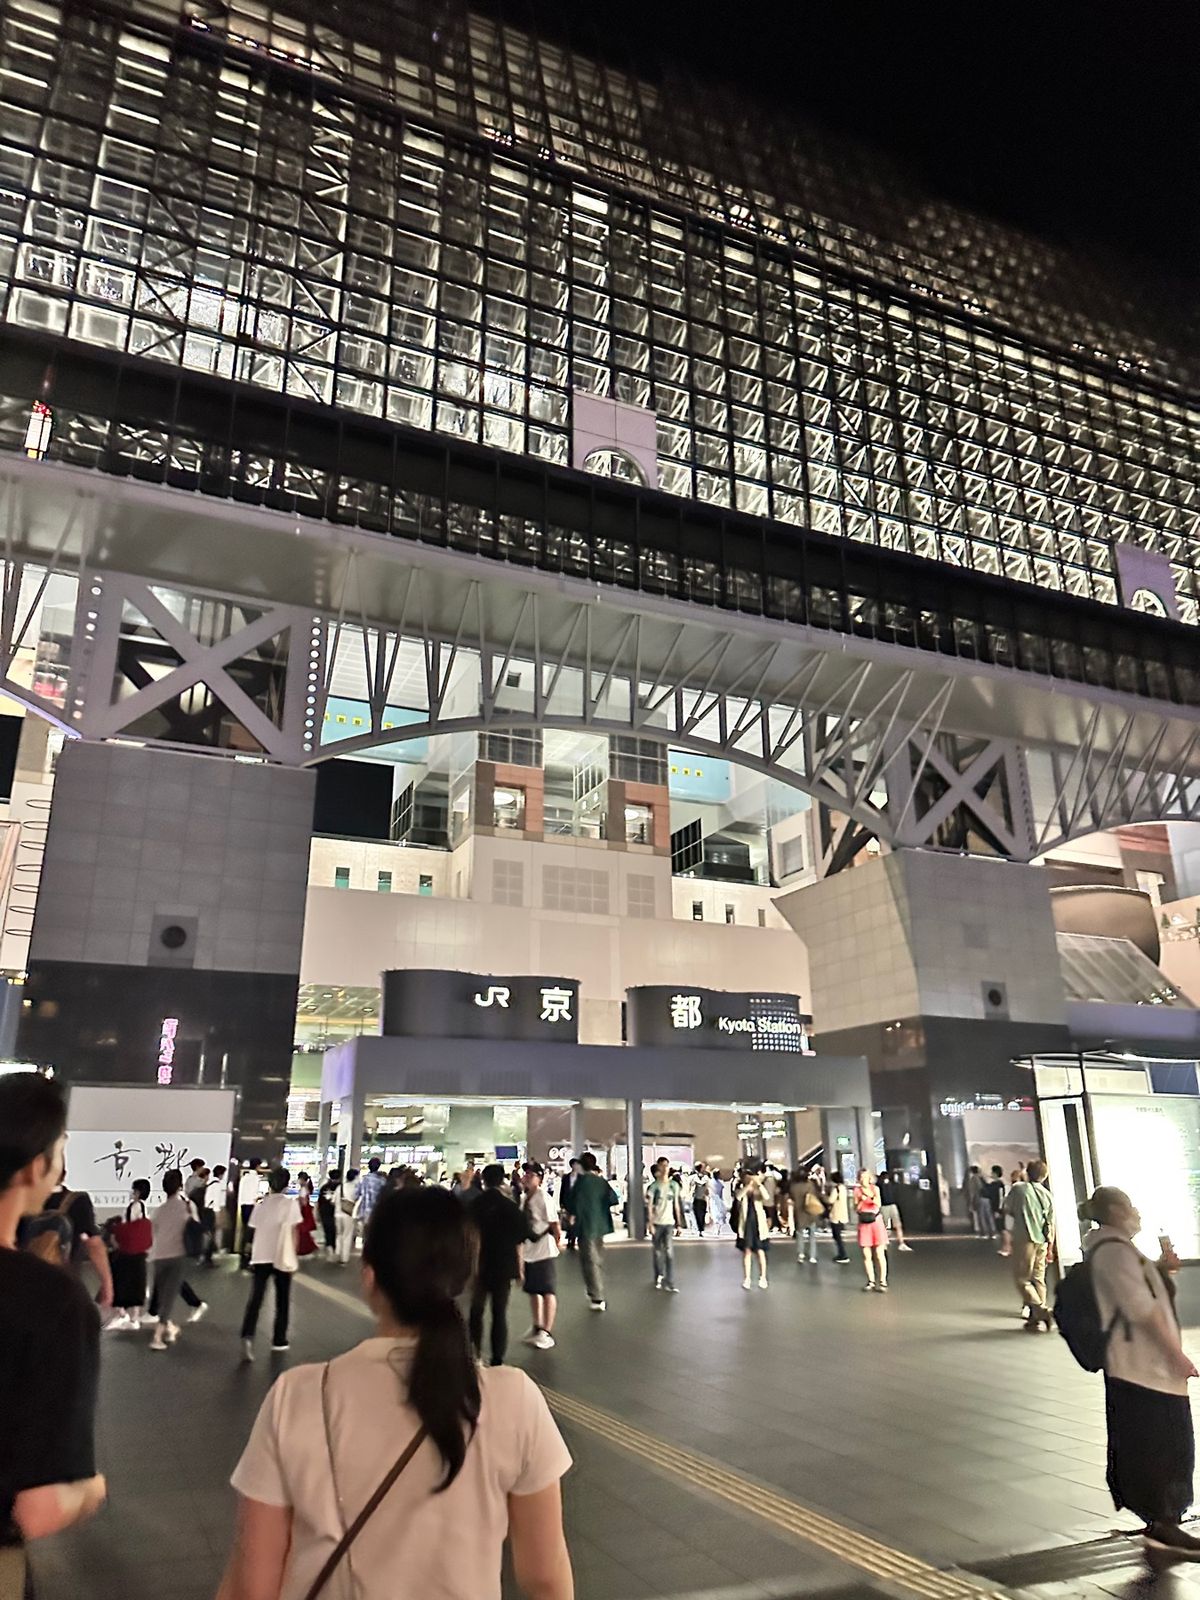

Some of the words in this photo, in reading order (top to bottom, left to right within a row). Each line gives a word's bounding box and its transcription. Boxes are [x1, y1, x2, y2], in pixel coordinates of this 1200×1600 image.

[475, 986, 511, 1008] JR
[540, 985, 574, 1022] 京
[670, 994, 703, 1030] 都
[718, 1016, 756, 1035] Kyoto
[757, 1016, 801, 1034] Station
